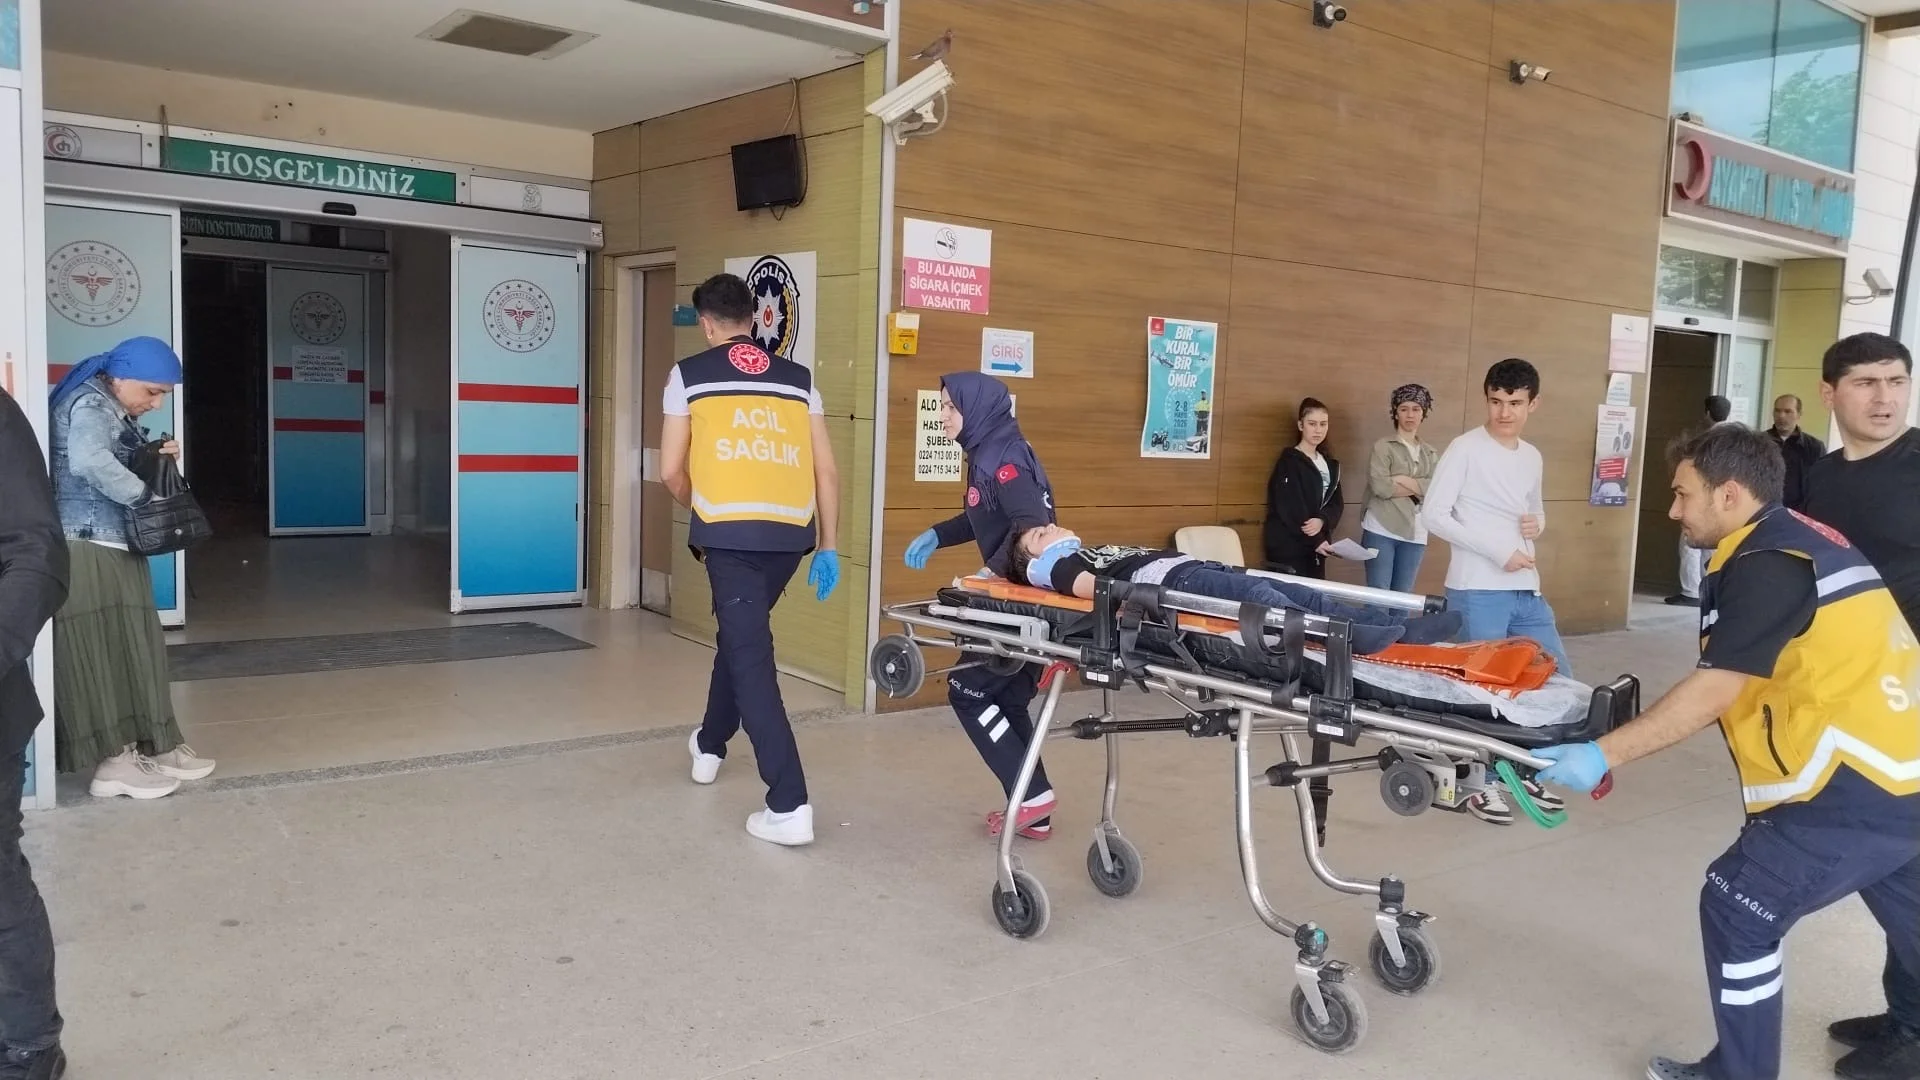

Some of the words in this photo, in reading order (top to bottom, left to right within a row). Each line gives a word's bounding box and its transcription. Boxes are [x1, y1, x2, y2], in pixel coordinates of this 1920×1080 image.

[209, 148, 415, 197] HOŞGELDİNİZ
[753, 264, 785, 286] POLİS
[917, 260, 933, 274] BU
[934, 263, 977, 280] ALANDA
[909, 275, 949, 293] SİGARA
[950, 279, 983, 297] İÇMEK
[920, 293, 971, 311] YASAKTIR
[1174, 325, 1194, 341] BİR
[991, 343, 1024, 362] GİRİŞ
[1165, 340, 1200, 356] KURAL
[1173, 355, 1193, 371] BİR
[1167, 369, 1198, 388] ÖMÜR
[920, 398, 937, 411] ALO
[732, 405, 787, 433] ACİL
[715, 433, 801, 468] SAĞLIK
[918, 450, 933, 460] 0224
[918, 464, 932, 474] 0224
[933, 464, 944, 474] 715
